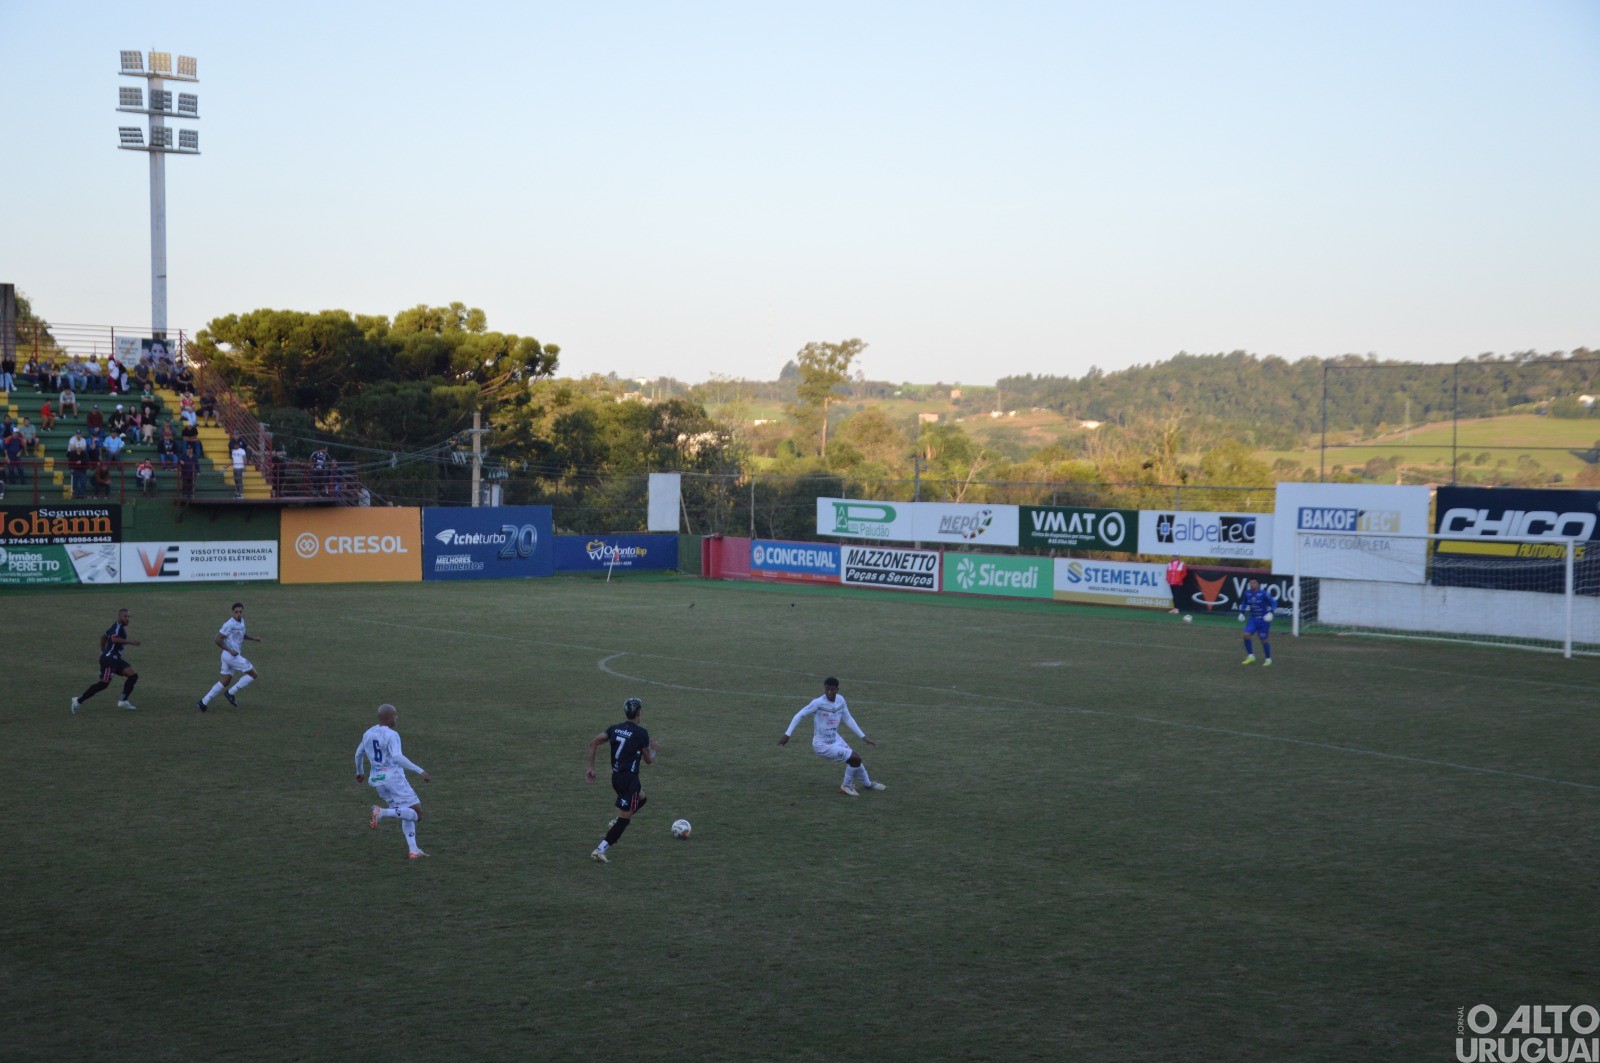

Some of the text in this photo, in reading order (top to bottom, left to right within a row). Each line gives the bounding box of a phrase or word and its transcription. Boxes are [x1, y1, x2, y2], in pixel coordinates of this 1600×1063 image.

[39, 508, 109, 518] Segurança
[939, 511, 980, 530] MEPÓ
[1302, 509, 1356, 529] BAKOF
[860, 523, 889, 537] Paludão
[1438, 508, 1597, 545] CHICO
[325, 536, 408, 554] CRESOL
[501, 524, 538, 557] 20
[1304, 536, 1391, 551] A MAIS COMPLETA
[604, 545, 648, 557] OontoTop
[766, 547, 836, 568] CONCREVAL
[846, 549, 937, 572] MAZZONETTO
[9, 560, 60, 571] PERETTO
[846, 569, 933, 586] Peças e Serviços
[978, 563, 1039, 589] Sicredi
[1084, 567, 1158, 587] STEMETAL
[372, 740, 383, 763] 6
[615, 736, 627, 759] 7
